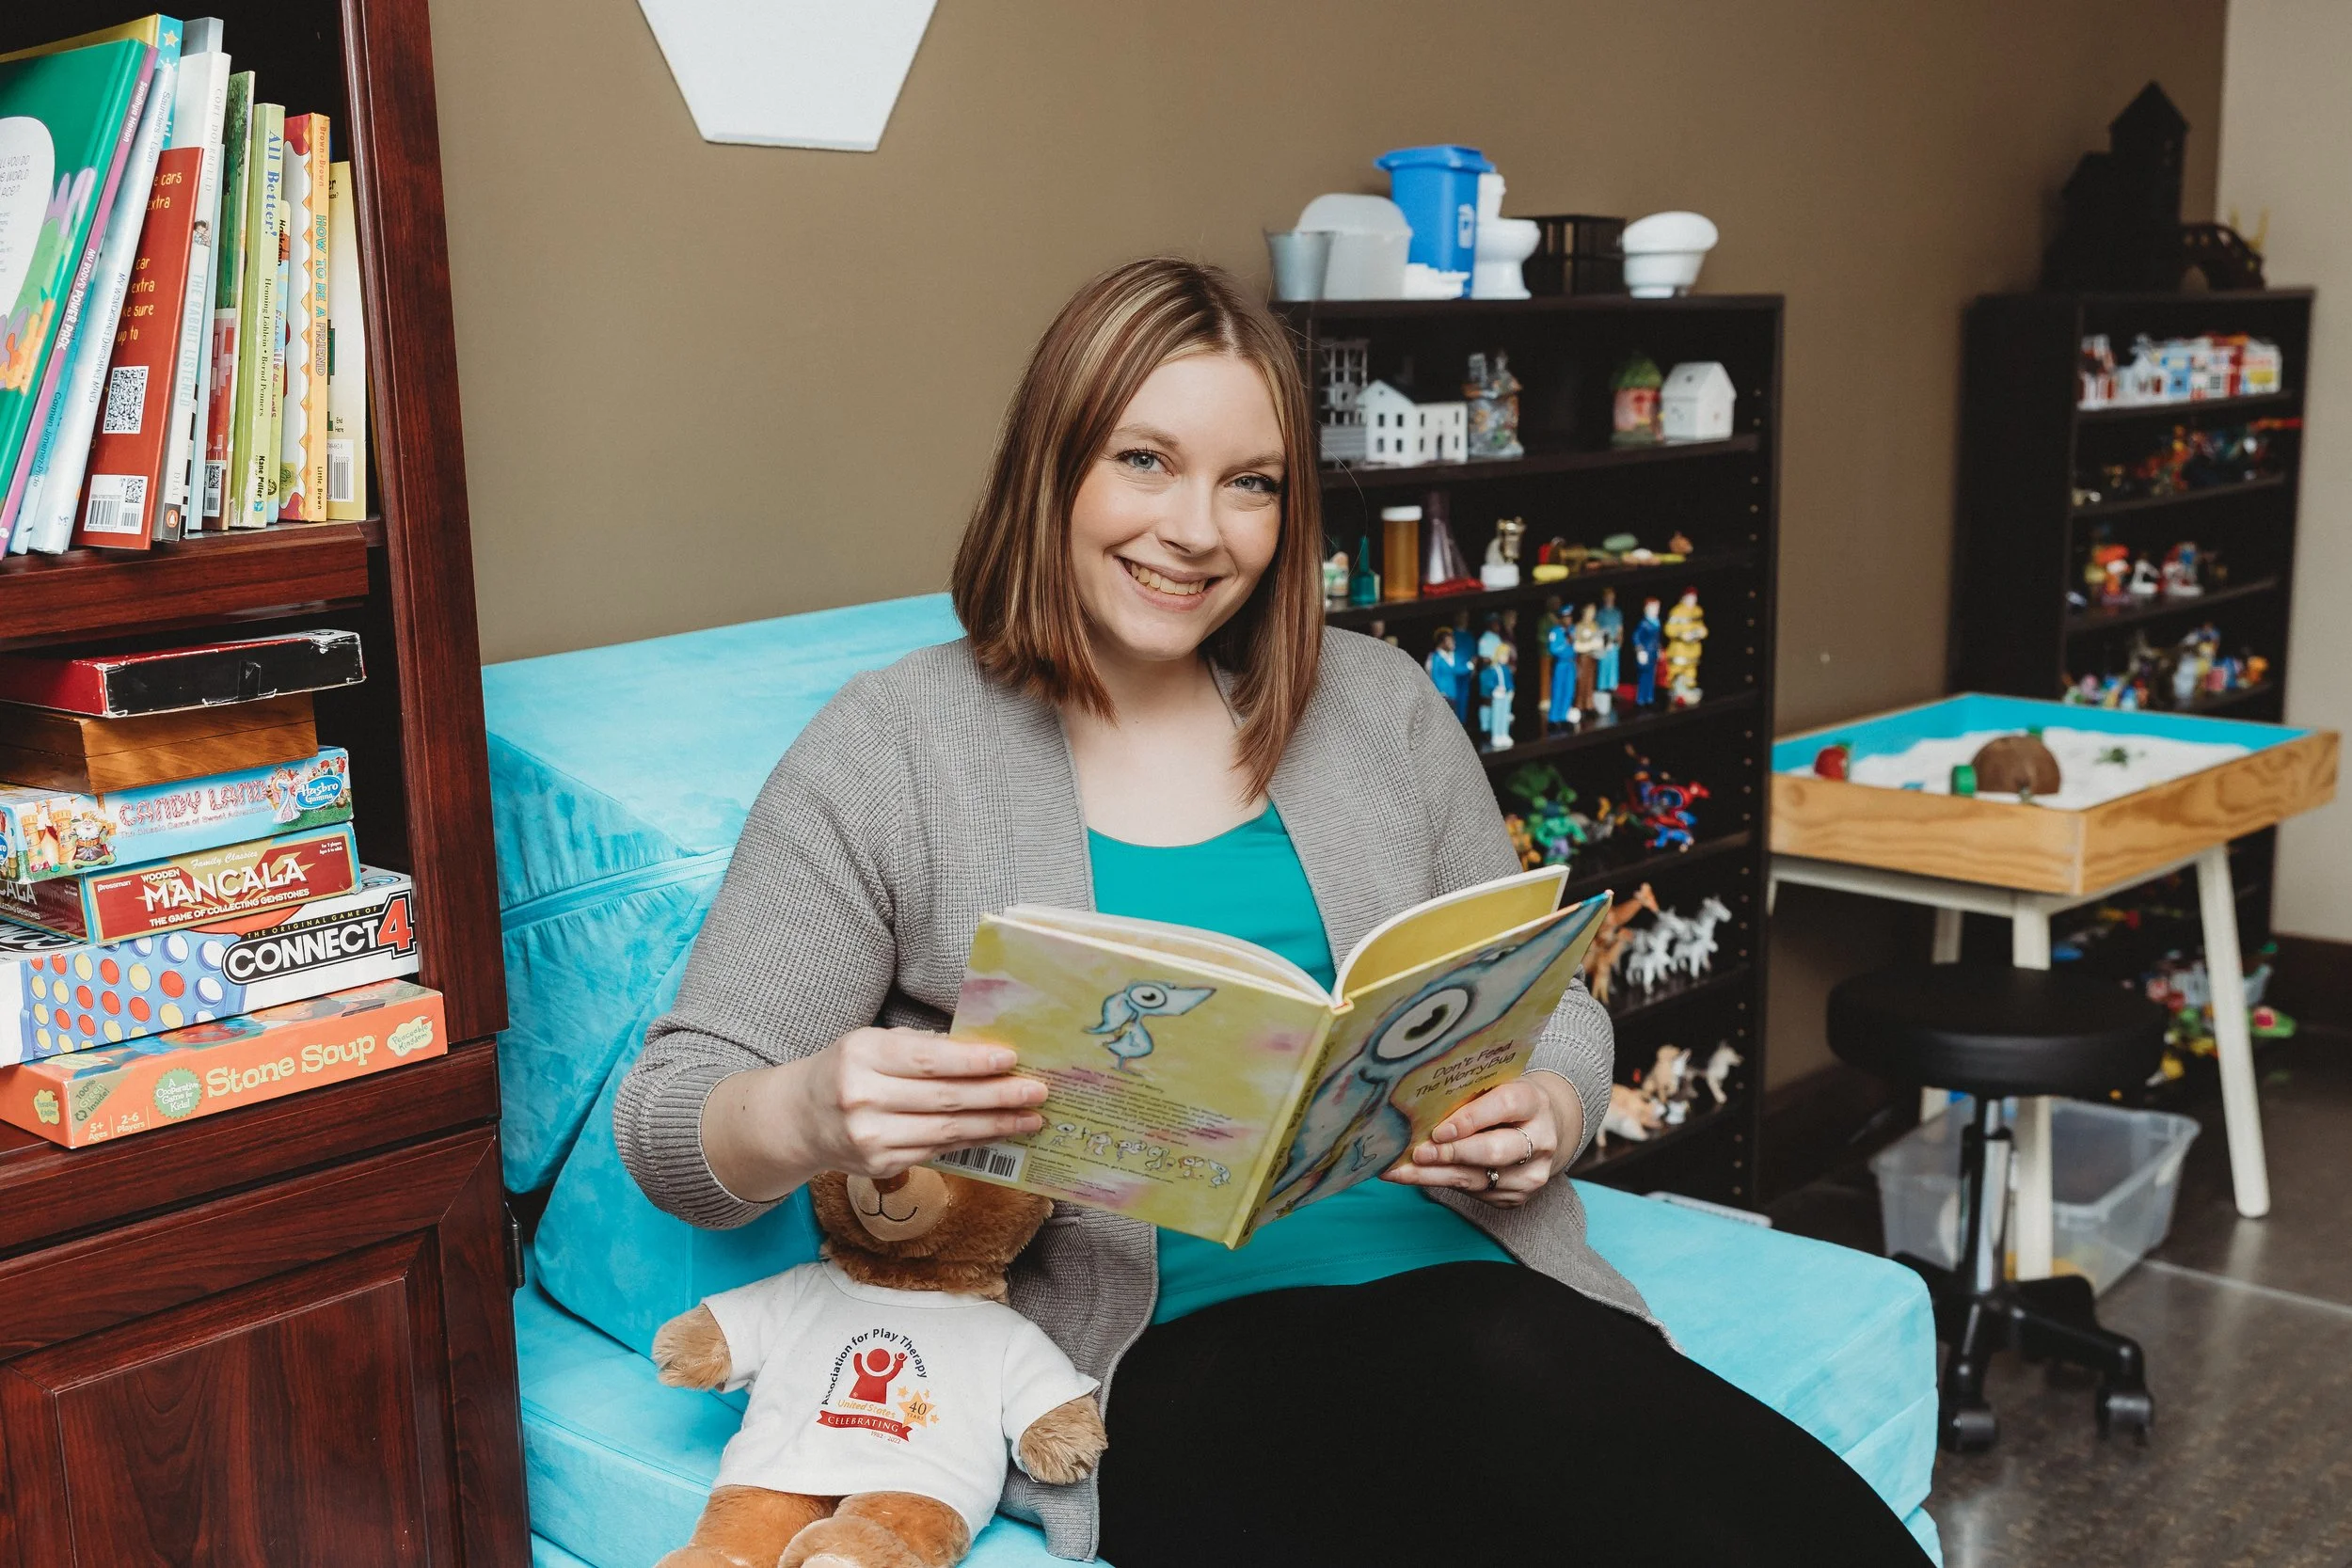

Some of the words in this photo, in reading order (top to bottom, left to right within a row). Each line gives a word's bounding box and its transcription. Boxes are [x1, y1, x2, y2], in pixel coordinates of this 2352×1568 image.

[132, 81, 148, 117] Sandhya
[154, 91, 170, 134] Saunders
[123, 118, 137, 143] Menon
[318, 126, 326, 153] Brown
[267, 129, 281, 161] All
[161, 172, 183, 186] cars
[316, 214, 326, 254] HOW
[86, 248, 96, 262] MY
[135, 257, 151, 271] car
[316, 259, 326, 279] TO
[131, 279, 155, 293] extra
[191, 274, 204, 297] THE
[262, 278, 271, 313] Henning
[316, 283, 326, 302] BE
[66, 289, 84, 325] POWER
[134, 303, 154, 317] sure
[316, 306, 326, 318] A
[186, 302, 201, 345] RABBIT
[56, 323, 73, 351] PACK
[117, 330, 127, 346] up
[130, 325, 139, 341] to
[315, 322, 326, 376] FRIEND
[260, 356, 268, 380] Bernd
[46, 392, 61, 428] Carmen
[298, 782, 339, 797] Hasbro
[305, 791, 333, 804] Gaming
[119, 790, 201, 827] CANDY
[208, 780, 267, 811] LAND
[190, 855, 223, 870] Family
[225, 849, 259, 863] Classics
[141, 869, 181, 883] WOODEN
[143, 857, 307, 912] MANCALA
[149, 916, 167, 927] THE
[167, 911, 194, 924] GAME
[194, 908, 207, 918] OF
[207, 897, 260, 916] COLLECTING
[260, 888, 310, 906] GEMSTONES
[246, 928, 266, 940] THE
[271, 918, 327, 934] ORIGINAL
[331, 910, 360, 921] GAME
[365, 906, 378, 914] OF
[228, 919, 379, 978] CONNECT
[377, 897, 413, 951] 4
[391, 1023, 429, 1046] Peaceable
[398, 1032, 428, 1052] Kingdom
[205, 1055, 295, 1099] Stone
[300, 1035, 376, 1074] Soup
[1433, 1056, 1474, 1080] Don't
[1477, 1039, 1514, 1061] Feed
[168, 1078, 175, 1087] A
[1416, 1082, 1440, 1098] The
[1444, 1053, 1517, 1085] WorryBug
[76, 1079, 96, 1100] 100%
[78, 1082, 103, 1109] Green
[155, 1082, 200, 1098] Cooperative
[162, 1093, 183, 1105] Game
[184, 1091, 193, 1100] for
[87, 1088, 110, 1113] Inside!
[170, 1099, 190, 1113] Kids!
[89, 1121, 104, 1132] 5+
[116, 1121, 146, 1134] Players
[120, 1112, 139, 1124] 2-6
[87, 1130, 108, 1142] Ages
[820, 1345, 852, 1405] Association
[851, 1332, 869, 1346] for
[872, 1328, 898, 1342] Play
[899, 1336, 928, 1378] Therapy
[837, 1399, 866, 1411] United
[866, 1403, 897, 1419] States
[906, 1412, 924, 1420] YEARS
[909, 1401, 927, 1416] 40
[828, 1416, 899, 1433] CELEBRATING
